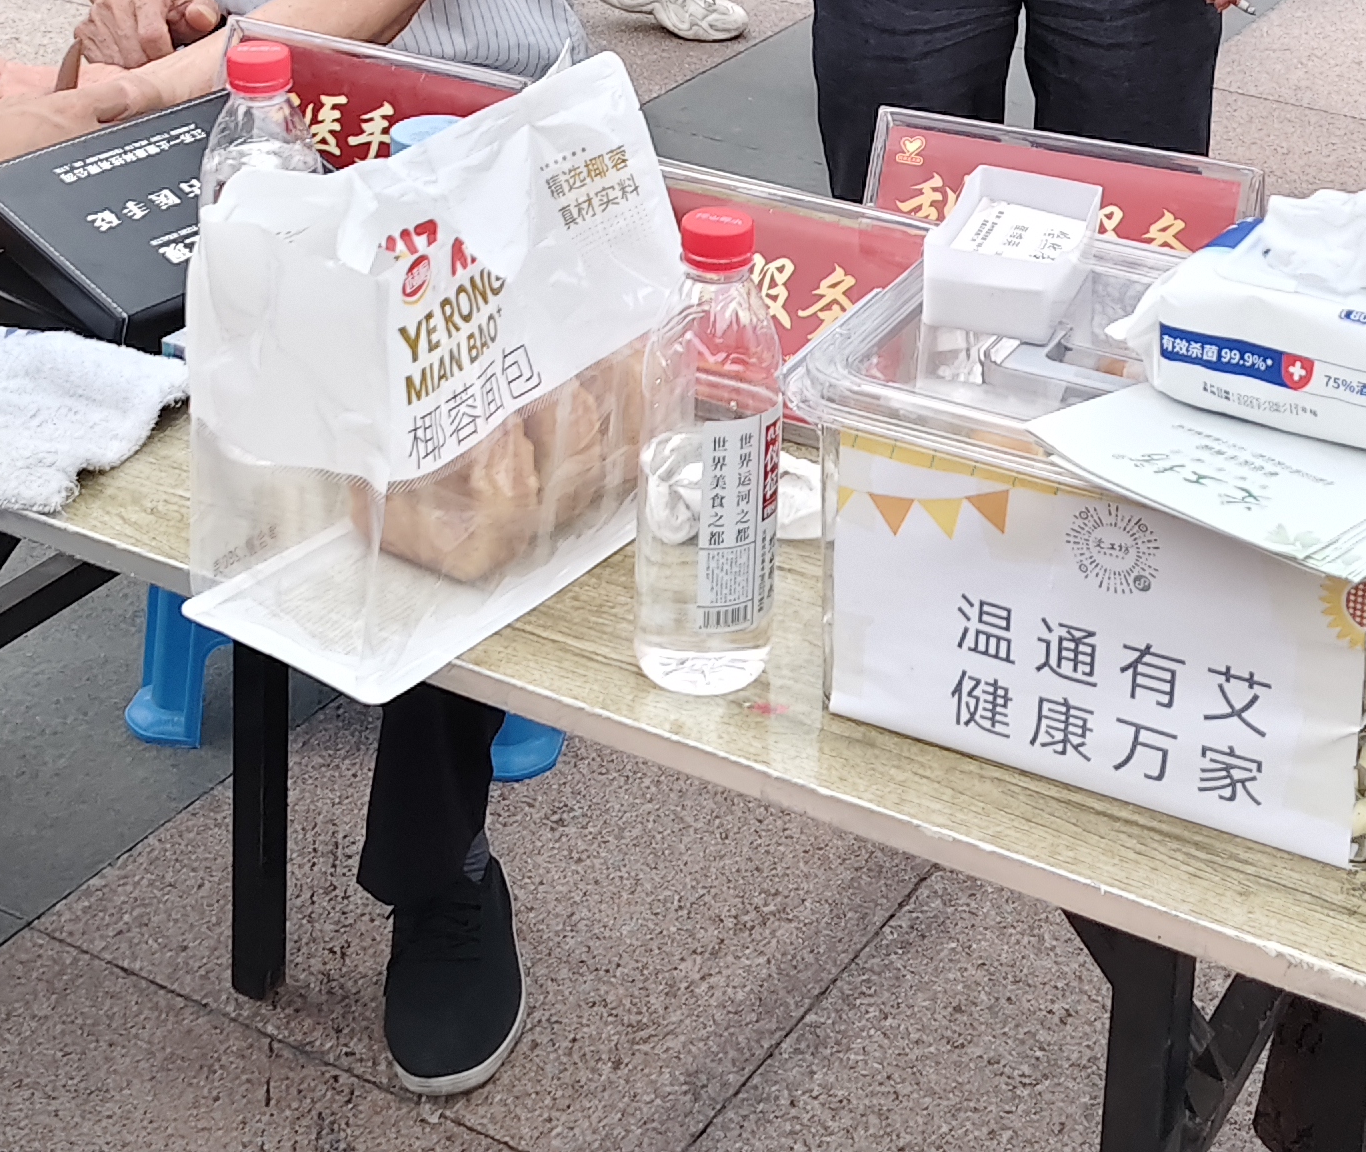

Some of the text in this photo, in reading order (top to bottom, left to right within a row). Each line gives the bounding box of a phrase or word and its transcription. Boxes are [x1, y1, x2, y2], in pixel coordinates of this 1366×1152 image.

[288, 92, 395, 163] 医手
[546, 145, 628, 199] 精选椰蓉
[558, 173, 639, 230] 真材实料
[398, 310, 440, 363] YE
[1162, 334, 1219, 362] 有效杀菌
[405, 342, 464, 405] MIAN
[407, 342, 543, 470] 椰蓉面包
[708, 436, 728, 546] 世界美食之都
[735, 432, 754, 544] 世界运河之都
[955, 593, 1272, 739] 温通有艾
[951, 669, 1265, 809] 健康万家
